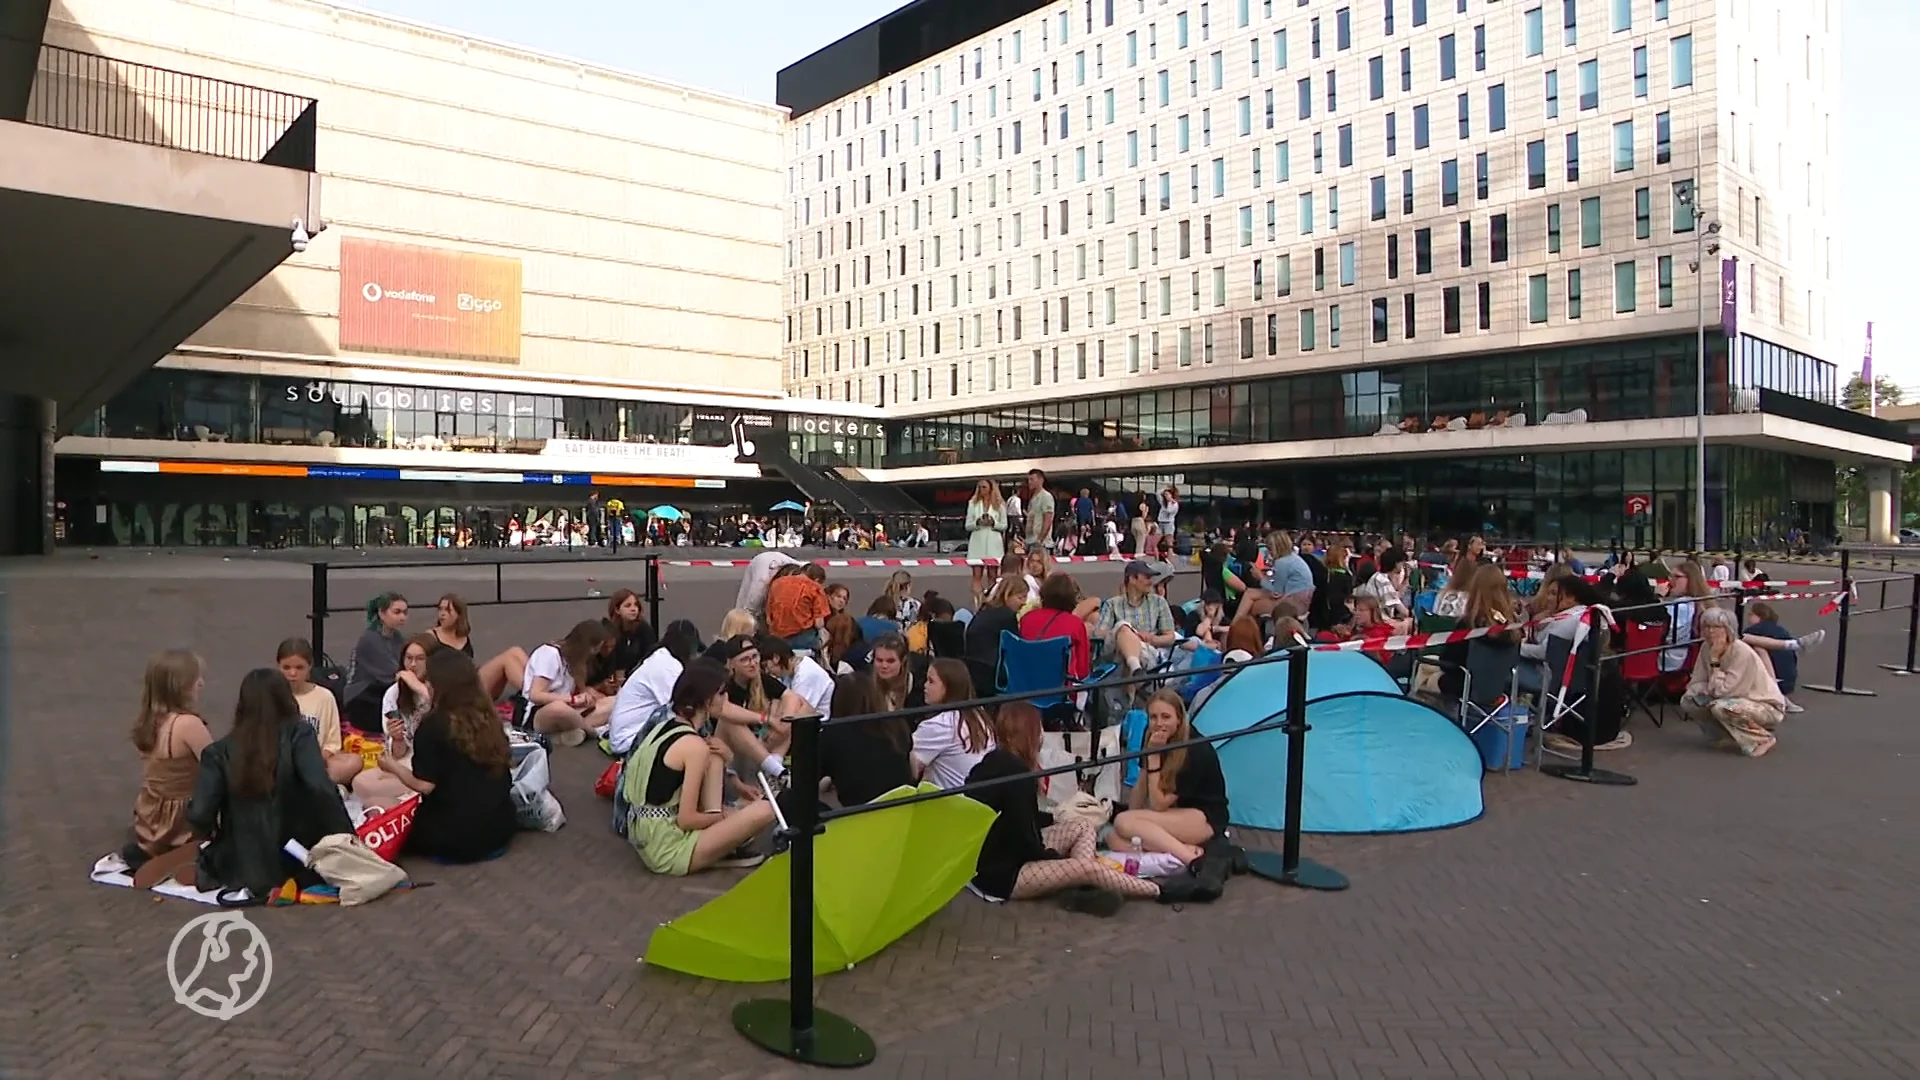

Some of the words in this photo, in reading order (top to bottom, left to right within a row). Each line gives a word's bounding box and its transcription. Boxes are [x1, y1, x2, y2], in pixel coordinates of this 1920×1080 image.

[383, 289, 436, 304] vodafone
[791, 415, 885, 438] lockers
[564, 443, 584, 454] EAT
[588, 444, 629, 456] BEFORE
[633, 446, 652, 457] THE
[1633, 503, 1643, 514] P
